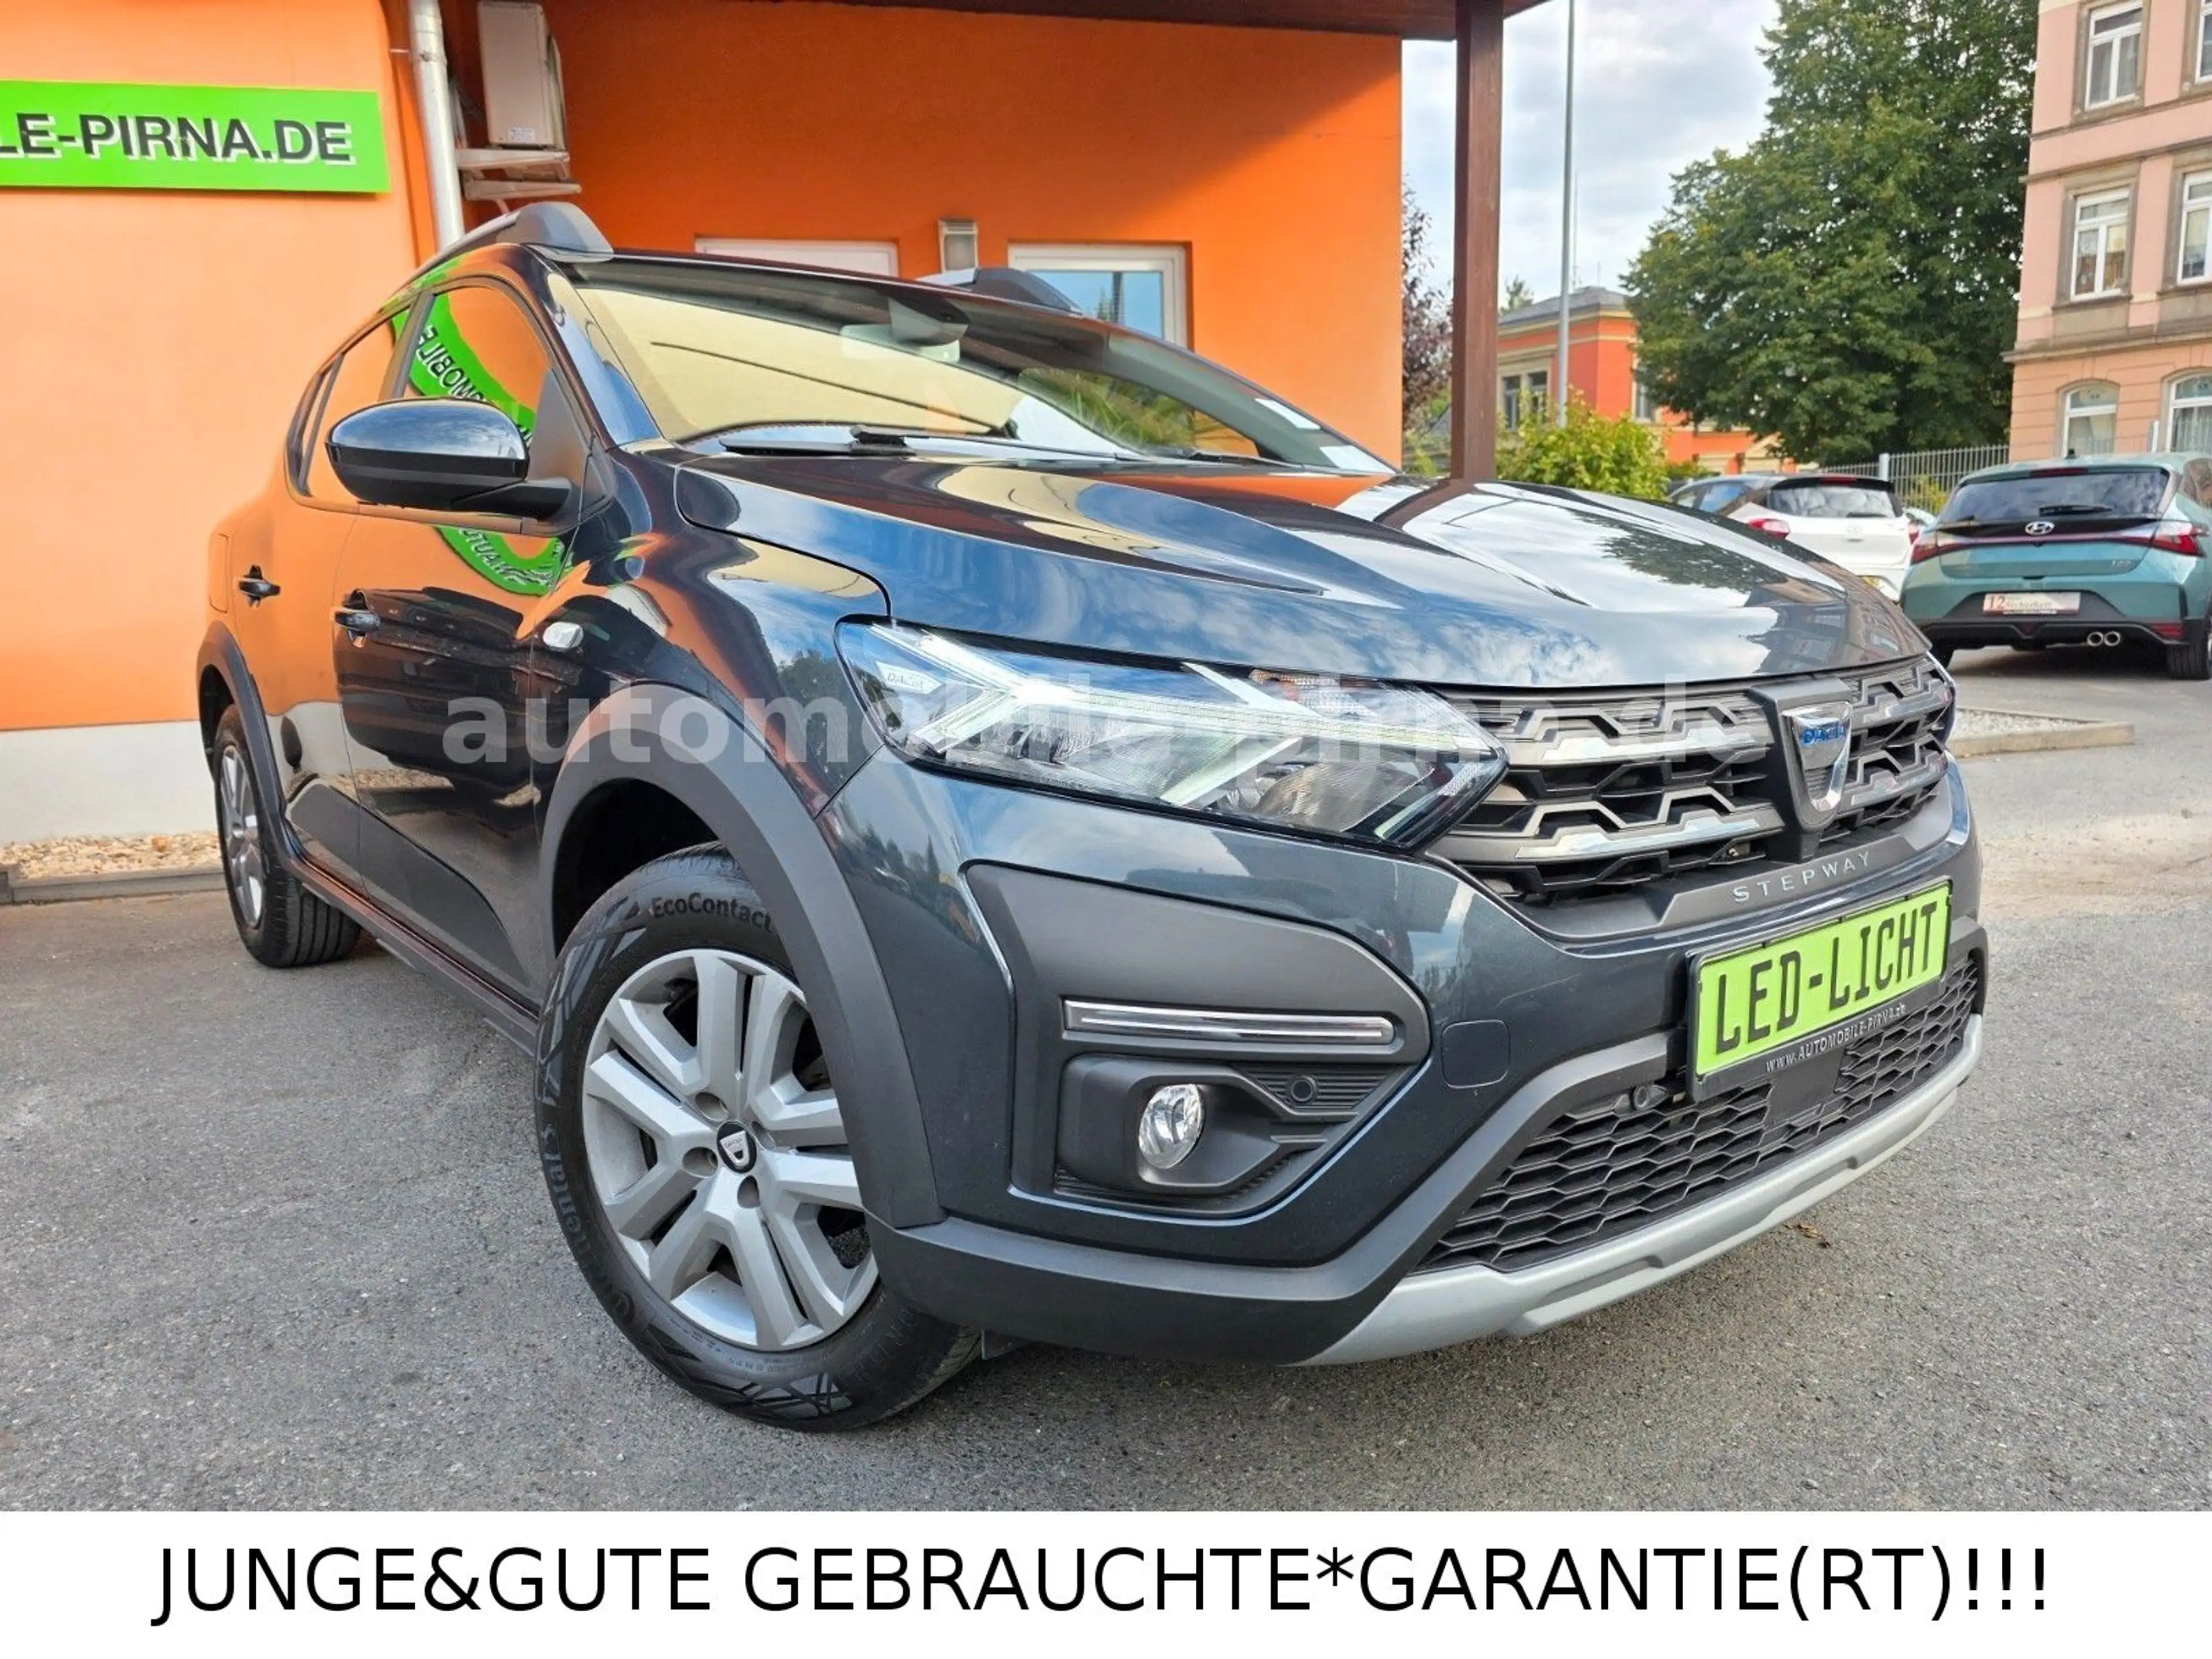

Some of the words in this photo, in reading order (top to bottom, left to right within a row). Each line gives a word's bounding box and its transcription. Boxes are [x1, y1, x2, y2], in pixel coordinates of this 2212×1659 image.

[1733, 851, 1870, 903] STEPWAY
[651, 891, 773, 933] EcoContact
[1715, 901, 1938, 1054] LED-LICHT
